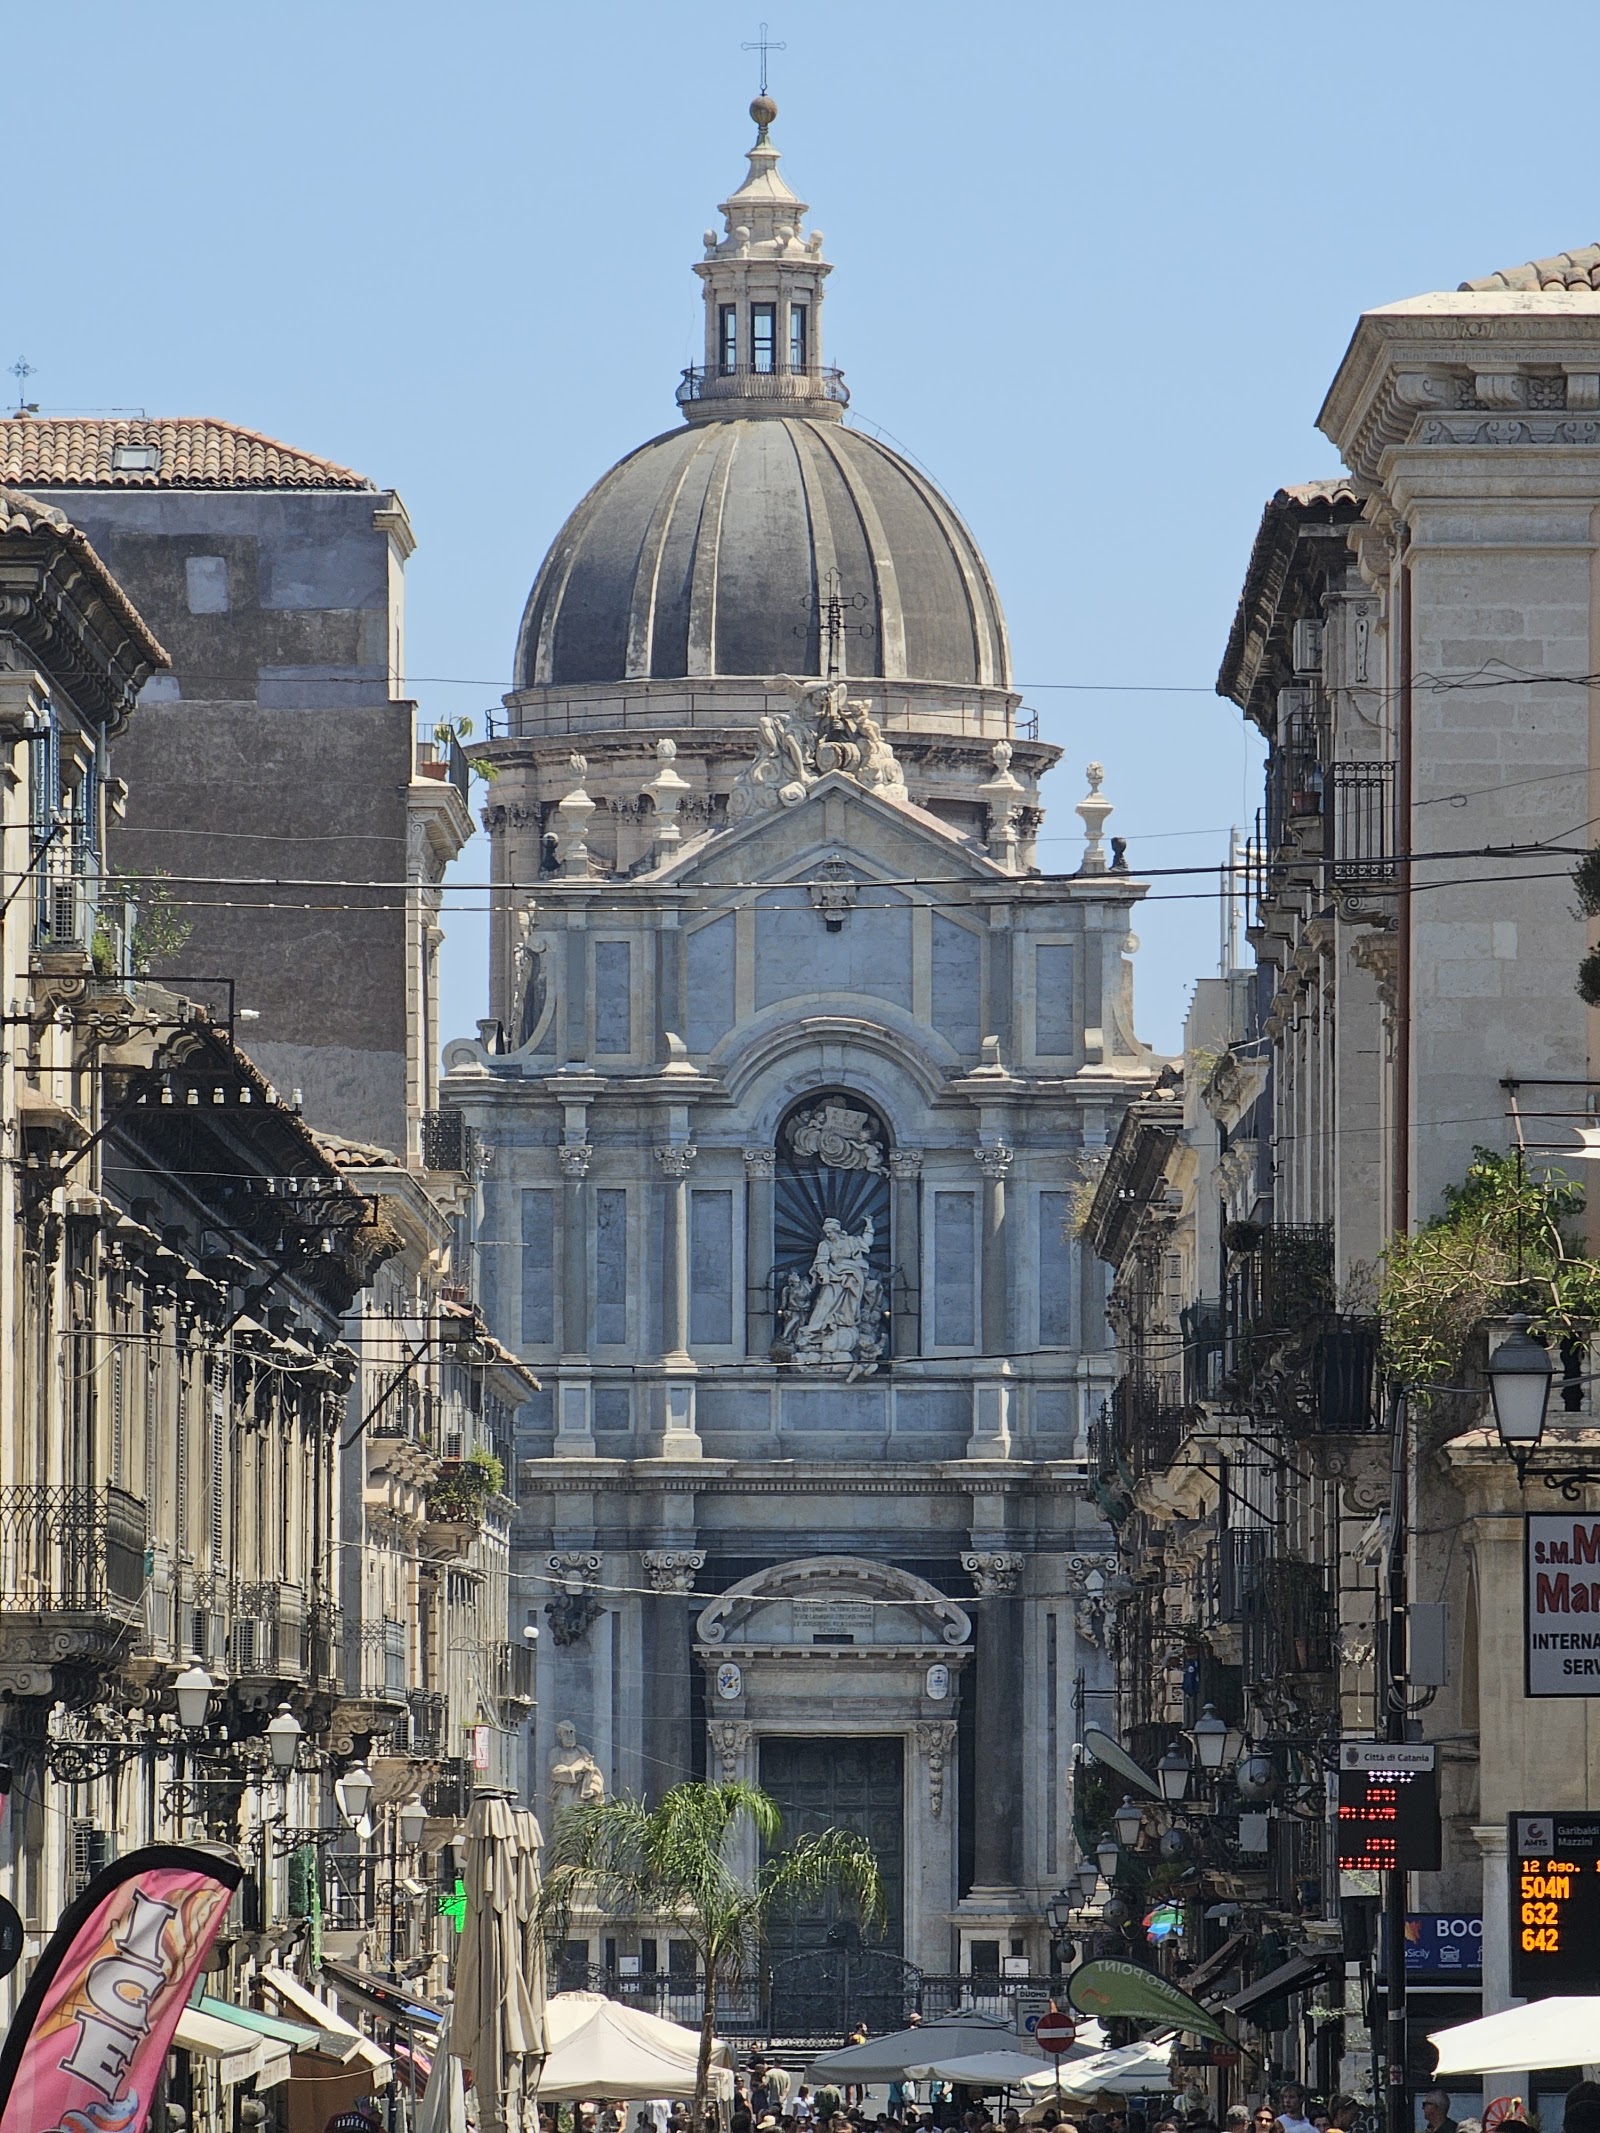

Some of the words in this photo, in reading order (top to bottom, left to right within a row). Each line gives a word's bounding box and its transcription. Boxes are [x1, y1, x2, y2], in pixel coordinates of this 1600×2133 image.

[1364, 1753, 1385, 1761] Città
[1387, 1753, 1395, 1761] di
[1398, 1754, 1429, 1762] Catania
[1558, 1826, 1600, 1836] Garibaldi
[1524, 1839, 1548, 1847] AMTS
[1558, 1837, 1593, 1847] Mazzini
[1523, 1860, 1540, 1873] 12
[1547, 1860, 1581, 1873] Ago.
[1521, 1876, 1570, 1899] 504M
[1522, 1902, 1559, 1925] 632
[1522, 1928, 1559, 1951] 642
[57, 1888, 178, 2105] ICE
